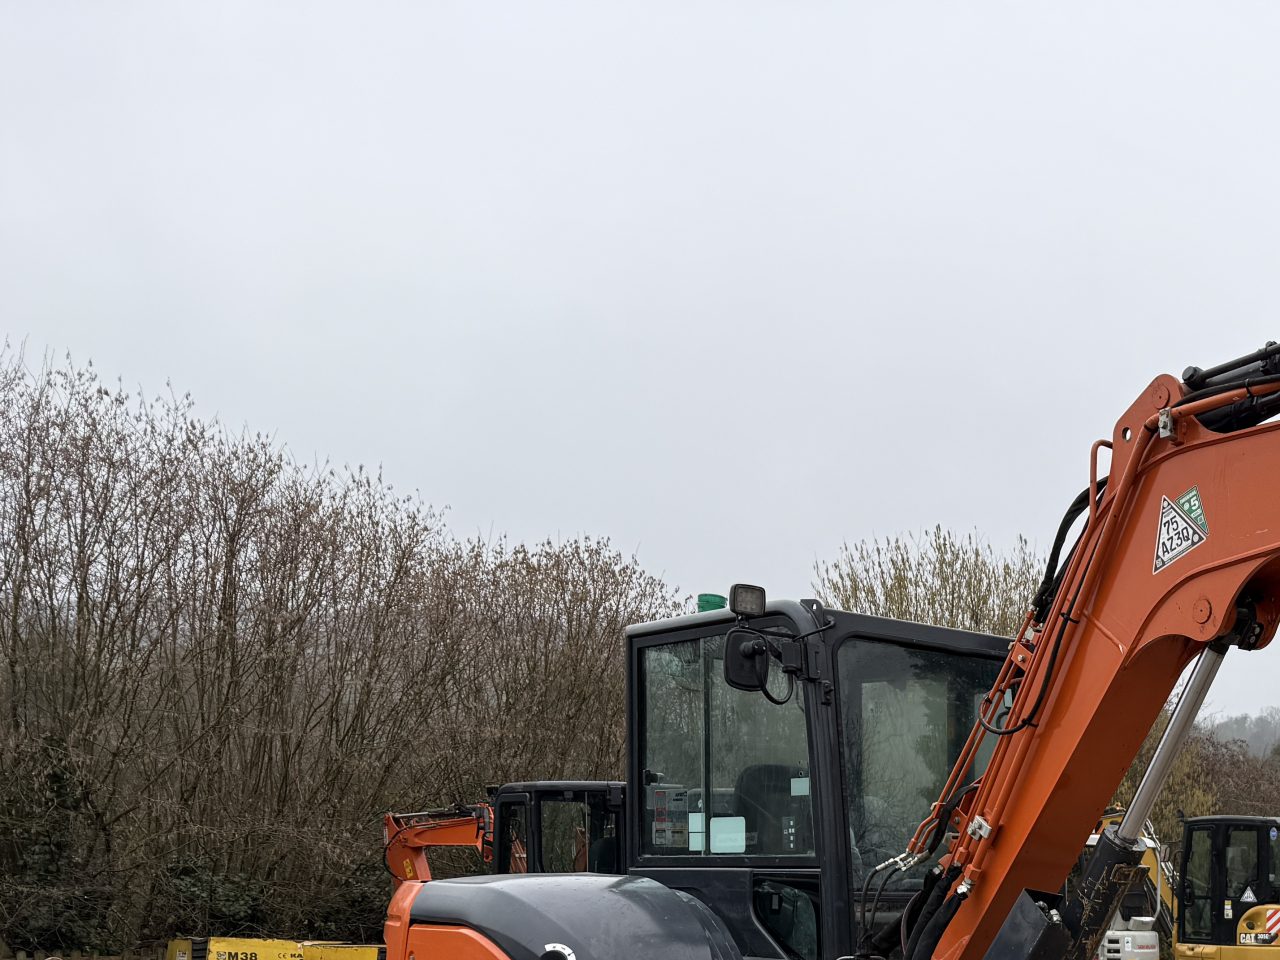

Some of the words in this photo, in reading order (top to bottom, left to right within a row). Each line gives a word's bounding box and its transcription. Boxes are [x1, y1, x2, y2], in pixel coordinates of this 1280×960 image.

[1190, 495, 1200, 510] 5
[1163, 515, 1179, 537] 75
[1161, 526, 1190, 558] AZ3Q
[1240, 933, 1256, 944] CAT
